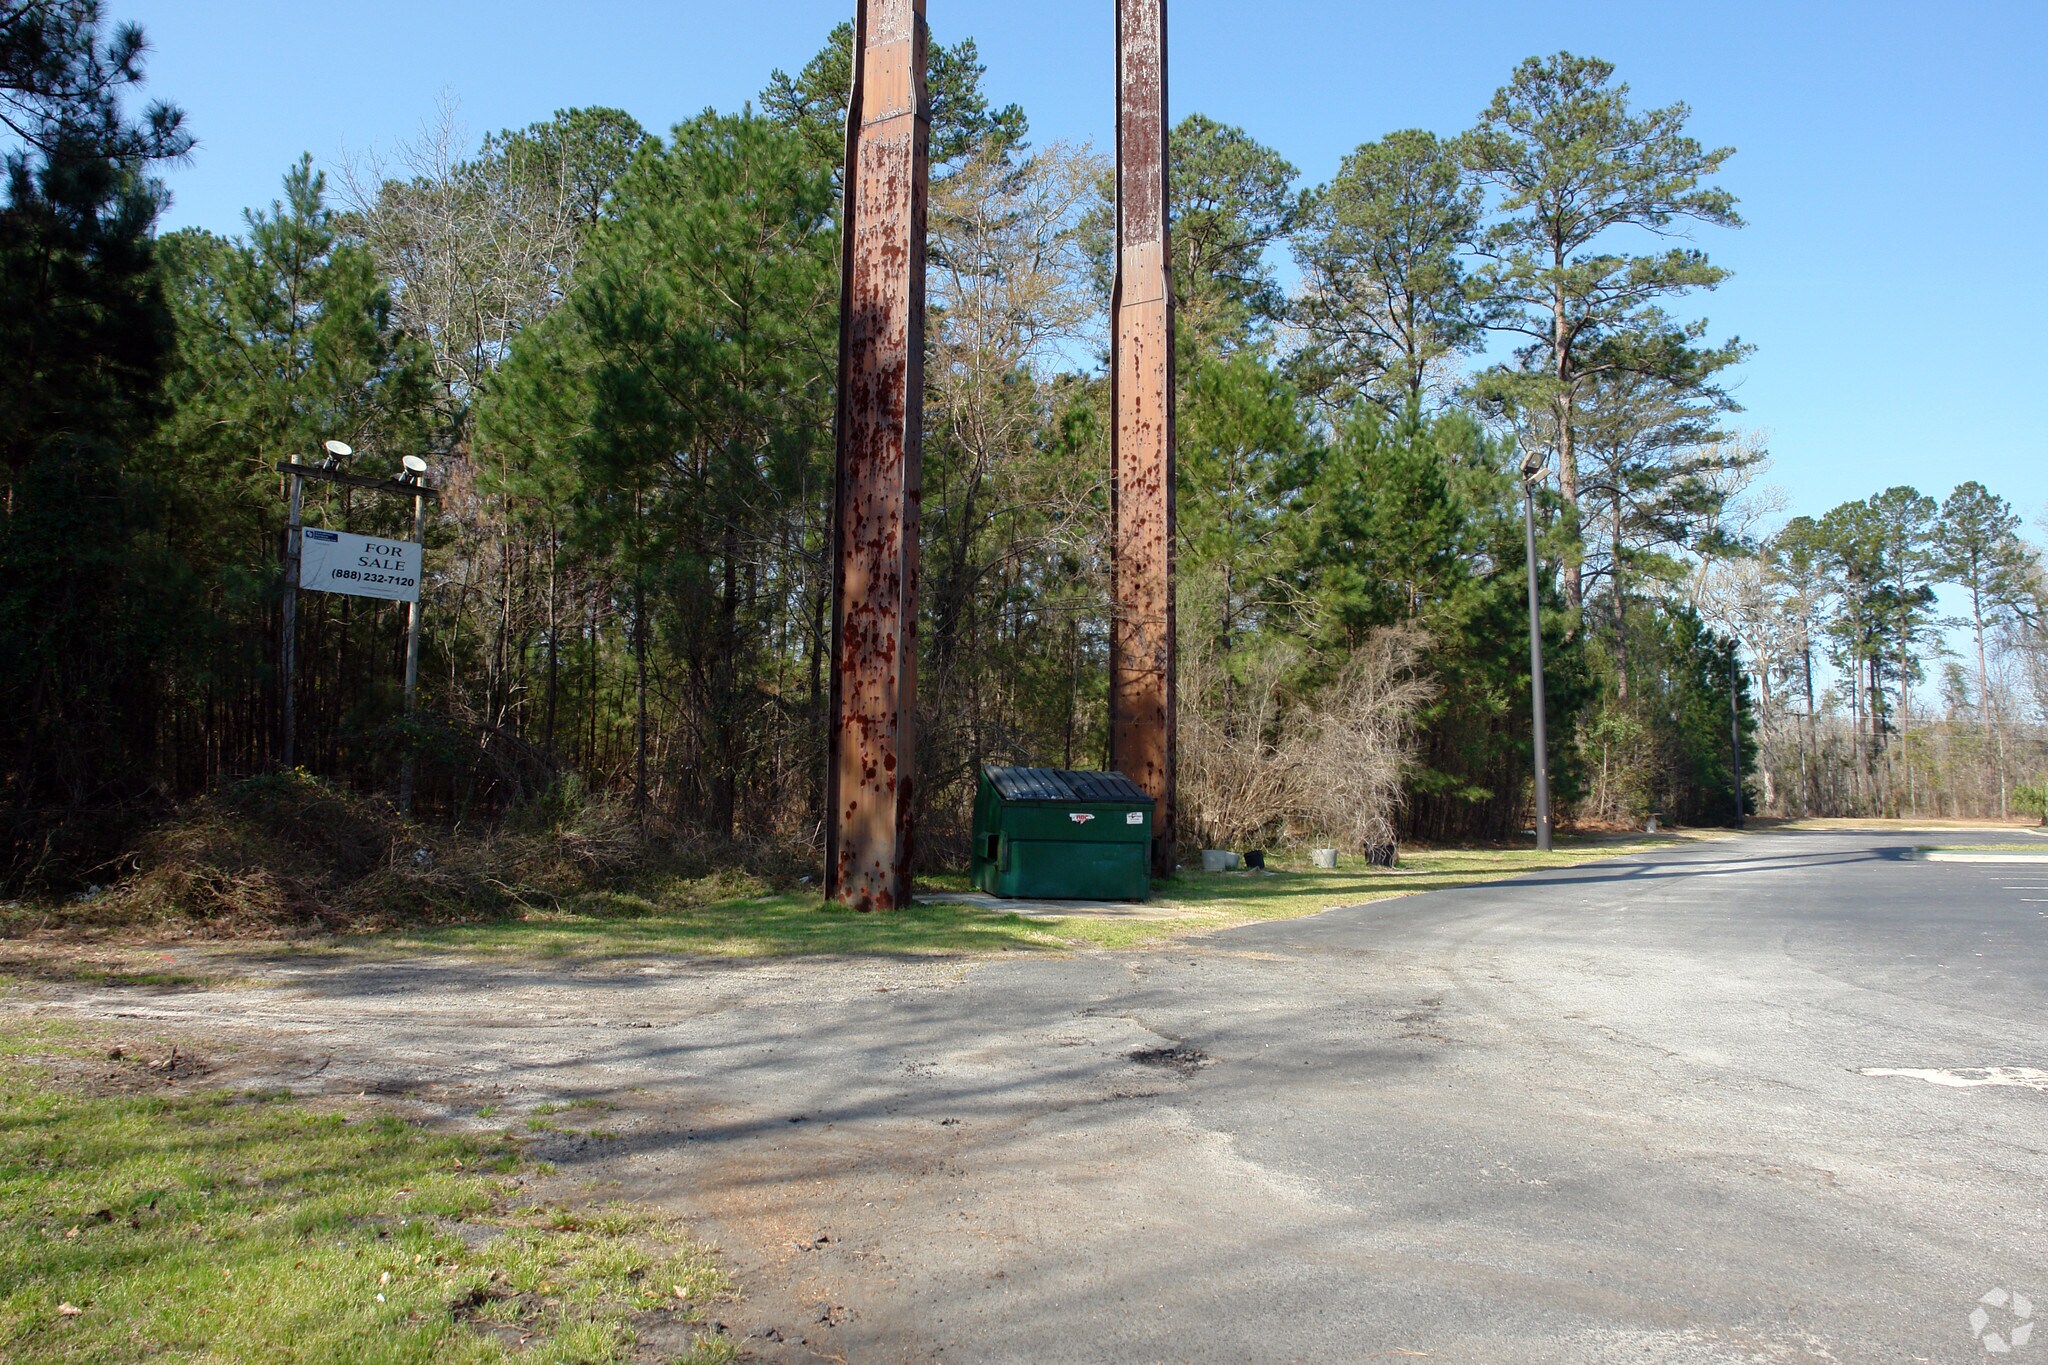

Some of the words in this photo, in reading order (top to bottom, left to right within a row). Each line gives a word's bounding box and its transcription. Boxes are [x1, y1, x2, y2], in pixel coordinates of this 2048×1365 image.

[365, 543, 402, 557] FOR
[358, 556, 406, 571] SALE
[331, 568, 361, 582] (888)
[363, 572, 415, 587] 232-7120
